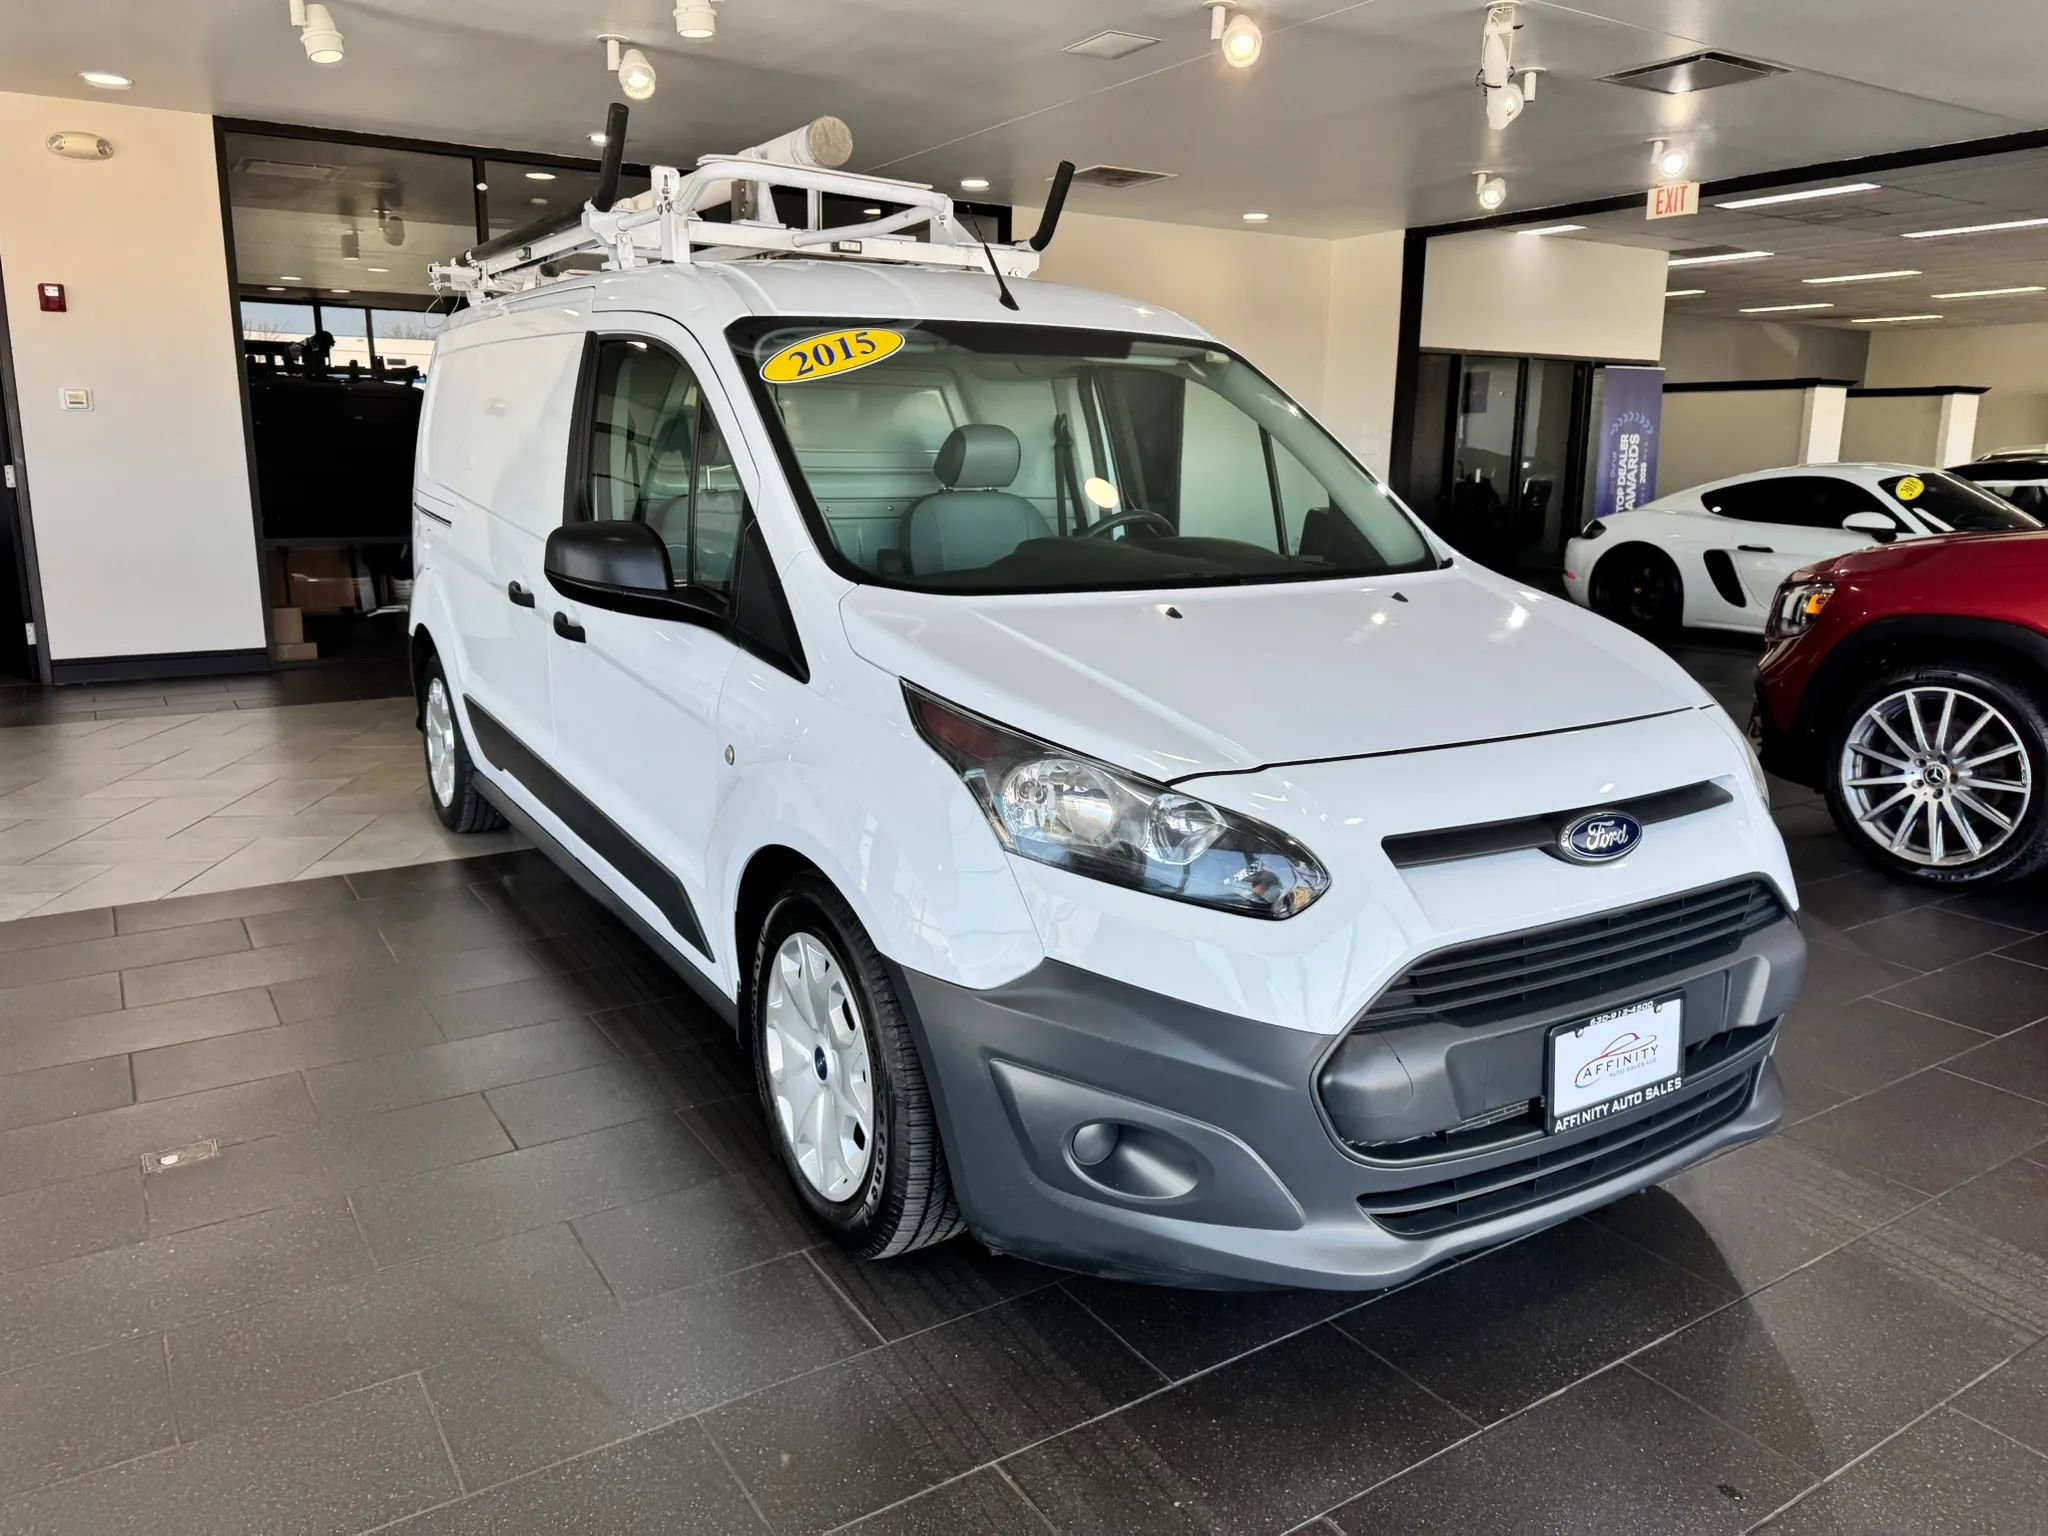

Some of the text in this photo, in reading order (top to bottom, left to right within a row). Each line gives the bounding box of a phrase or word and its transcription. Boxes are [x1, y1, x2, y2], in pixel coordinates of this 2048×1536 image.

[1655, 185, 1688, 215] EXIT
[788, 331, 877, 376] 2015
[1616, 433, 1630, 513] TOP DEALER
[1625, 433, 1641, 511] AWARDS
[1586, 820, 1629, 850] Ford
[1583, 1044, 1659, 1079] AFFINITY
[1554, 1077, 1682, 1133] AFFINITY AUTO SALES
